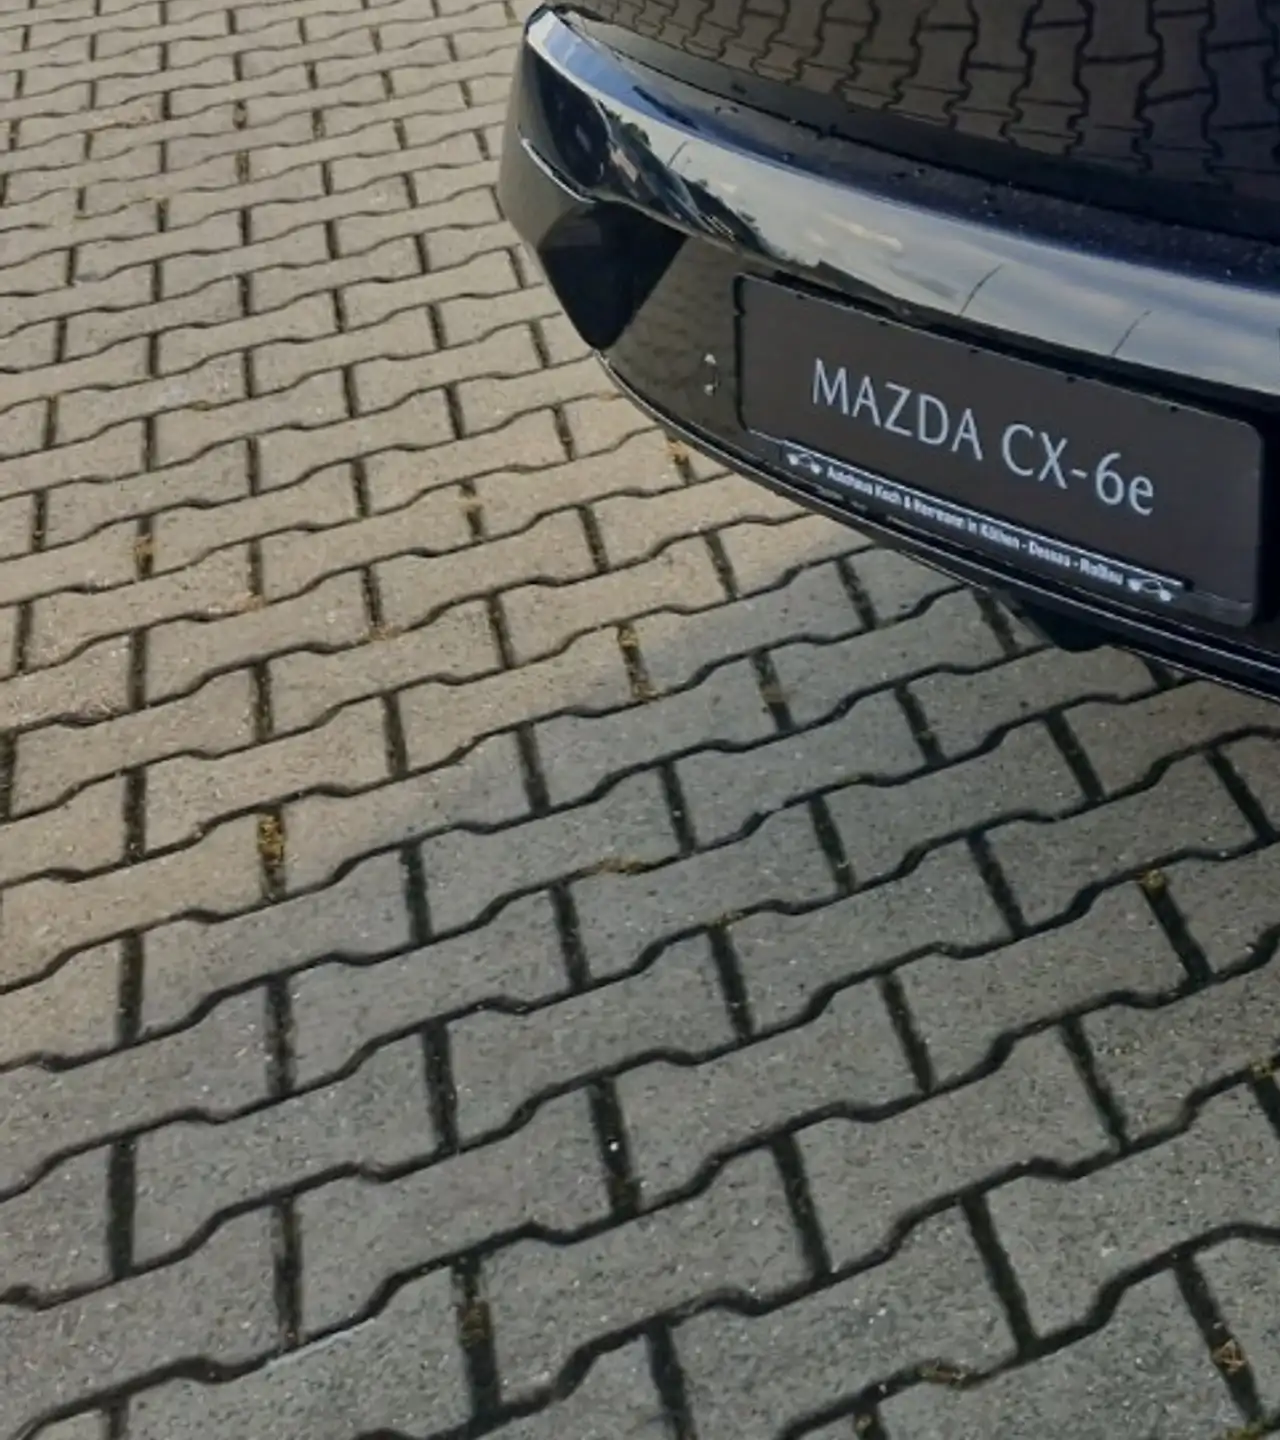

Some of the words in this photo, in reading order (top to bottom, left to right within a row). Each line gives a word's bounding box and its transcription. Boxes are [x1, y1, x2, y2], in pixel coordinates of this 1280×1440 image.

[811, 356, 984, 462] MAZDA
[1001, 422, 1155, 517] CX-6e
[874, 483, 903, 506] Koch
